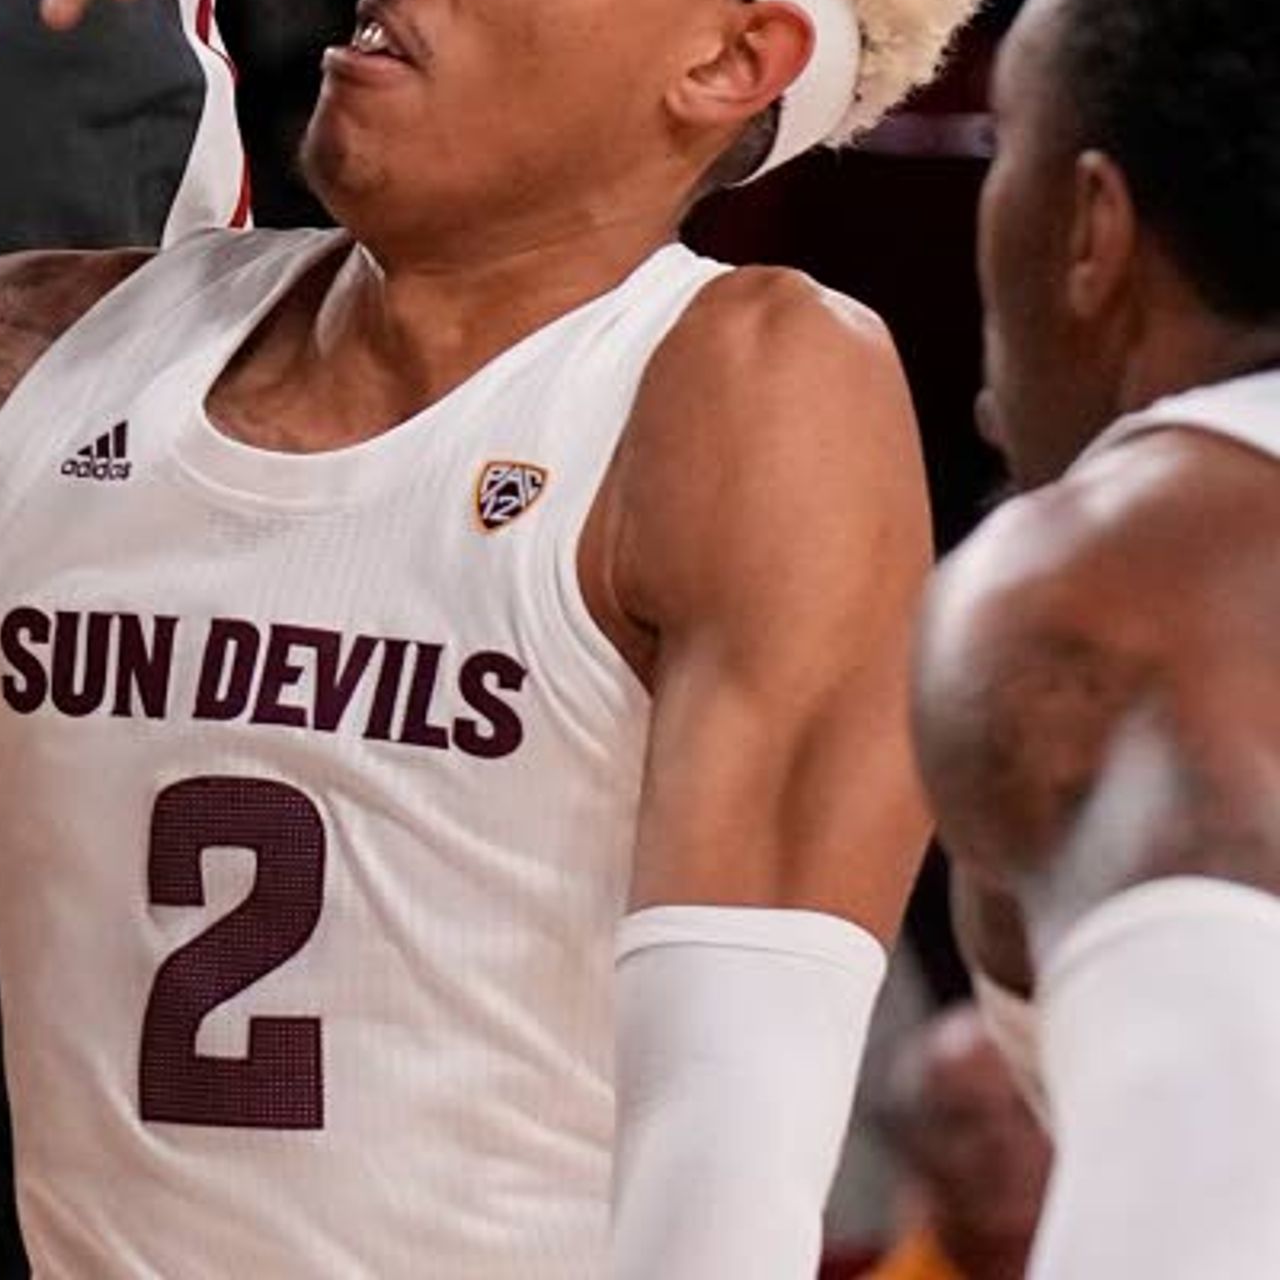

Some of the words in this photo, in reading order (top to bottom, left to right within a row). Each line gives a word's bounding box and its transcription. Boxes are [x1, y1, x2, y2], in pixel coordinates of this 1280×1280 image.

[60, 457, 132, 481] adidas
[0, 606, 179, 719] SUN
[192, 617, 529, 759] DEVILS
[139, 775, 327, 1131] 2
